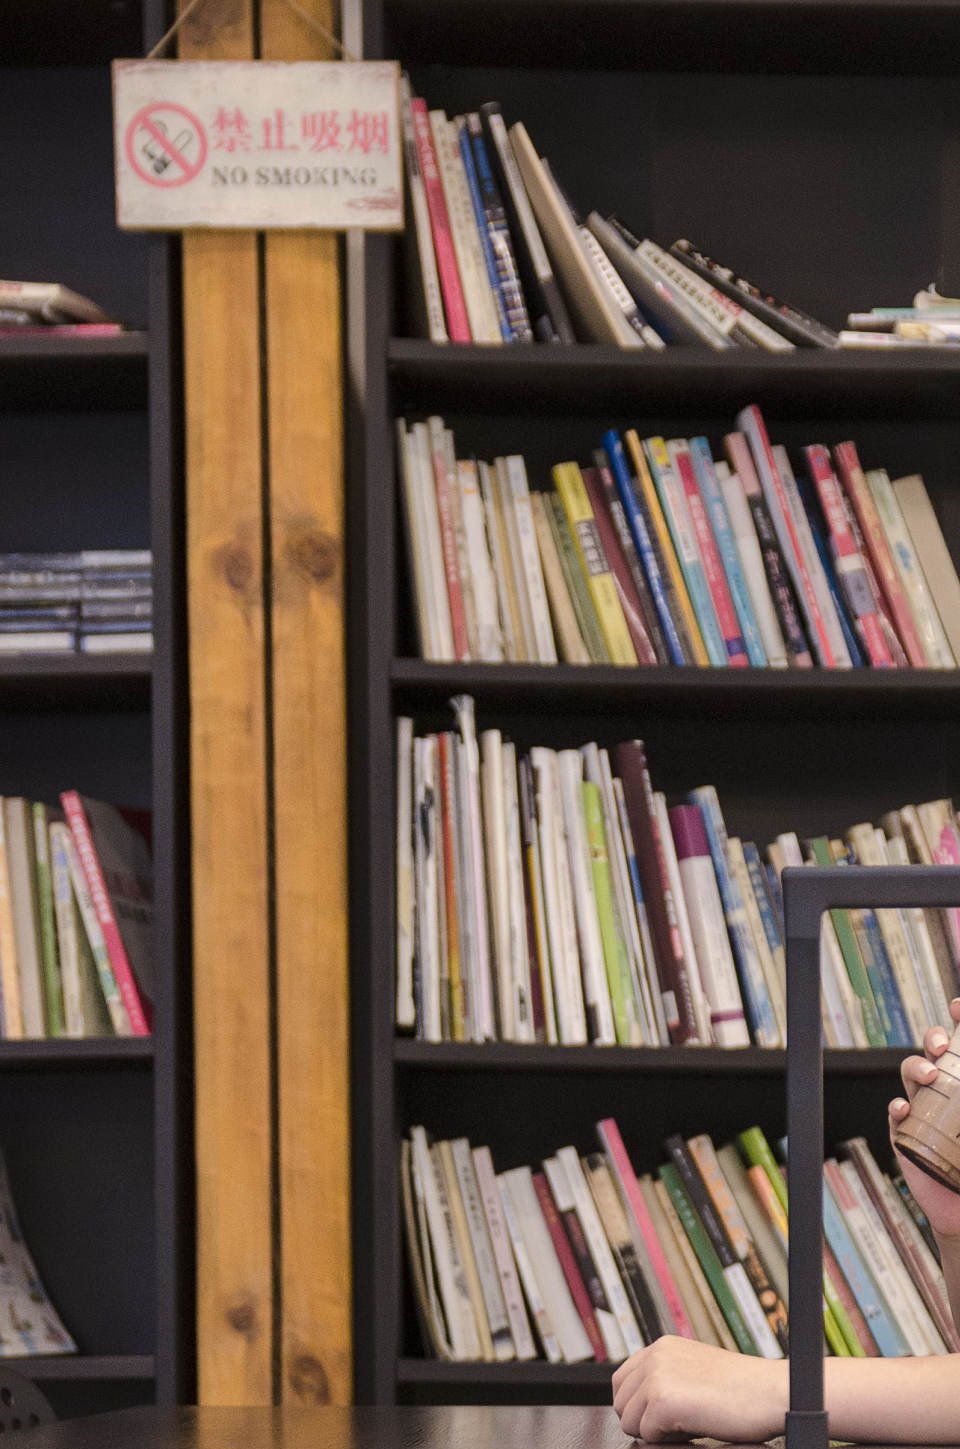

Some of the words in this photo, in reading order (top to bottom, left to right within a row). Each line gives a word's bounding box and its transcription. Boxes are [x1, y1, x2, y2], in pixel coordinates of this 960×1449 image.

[211, 105, 391, 154] 禁止吸烟
[211, 166, 248, 187] NO
[255, 166, 377, 187] SMOKING
